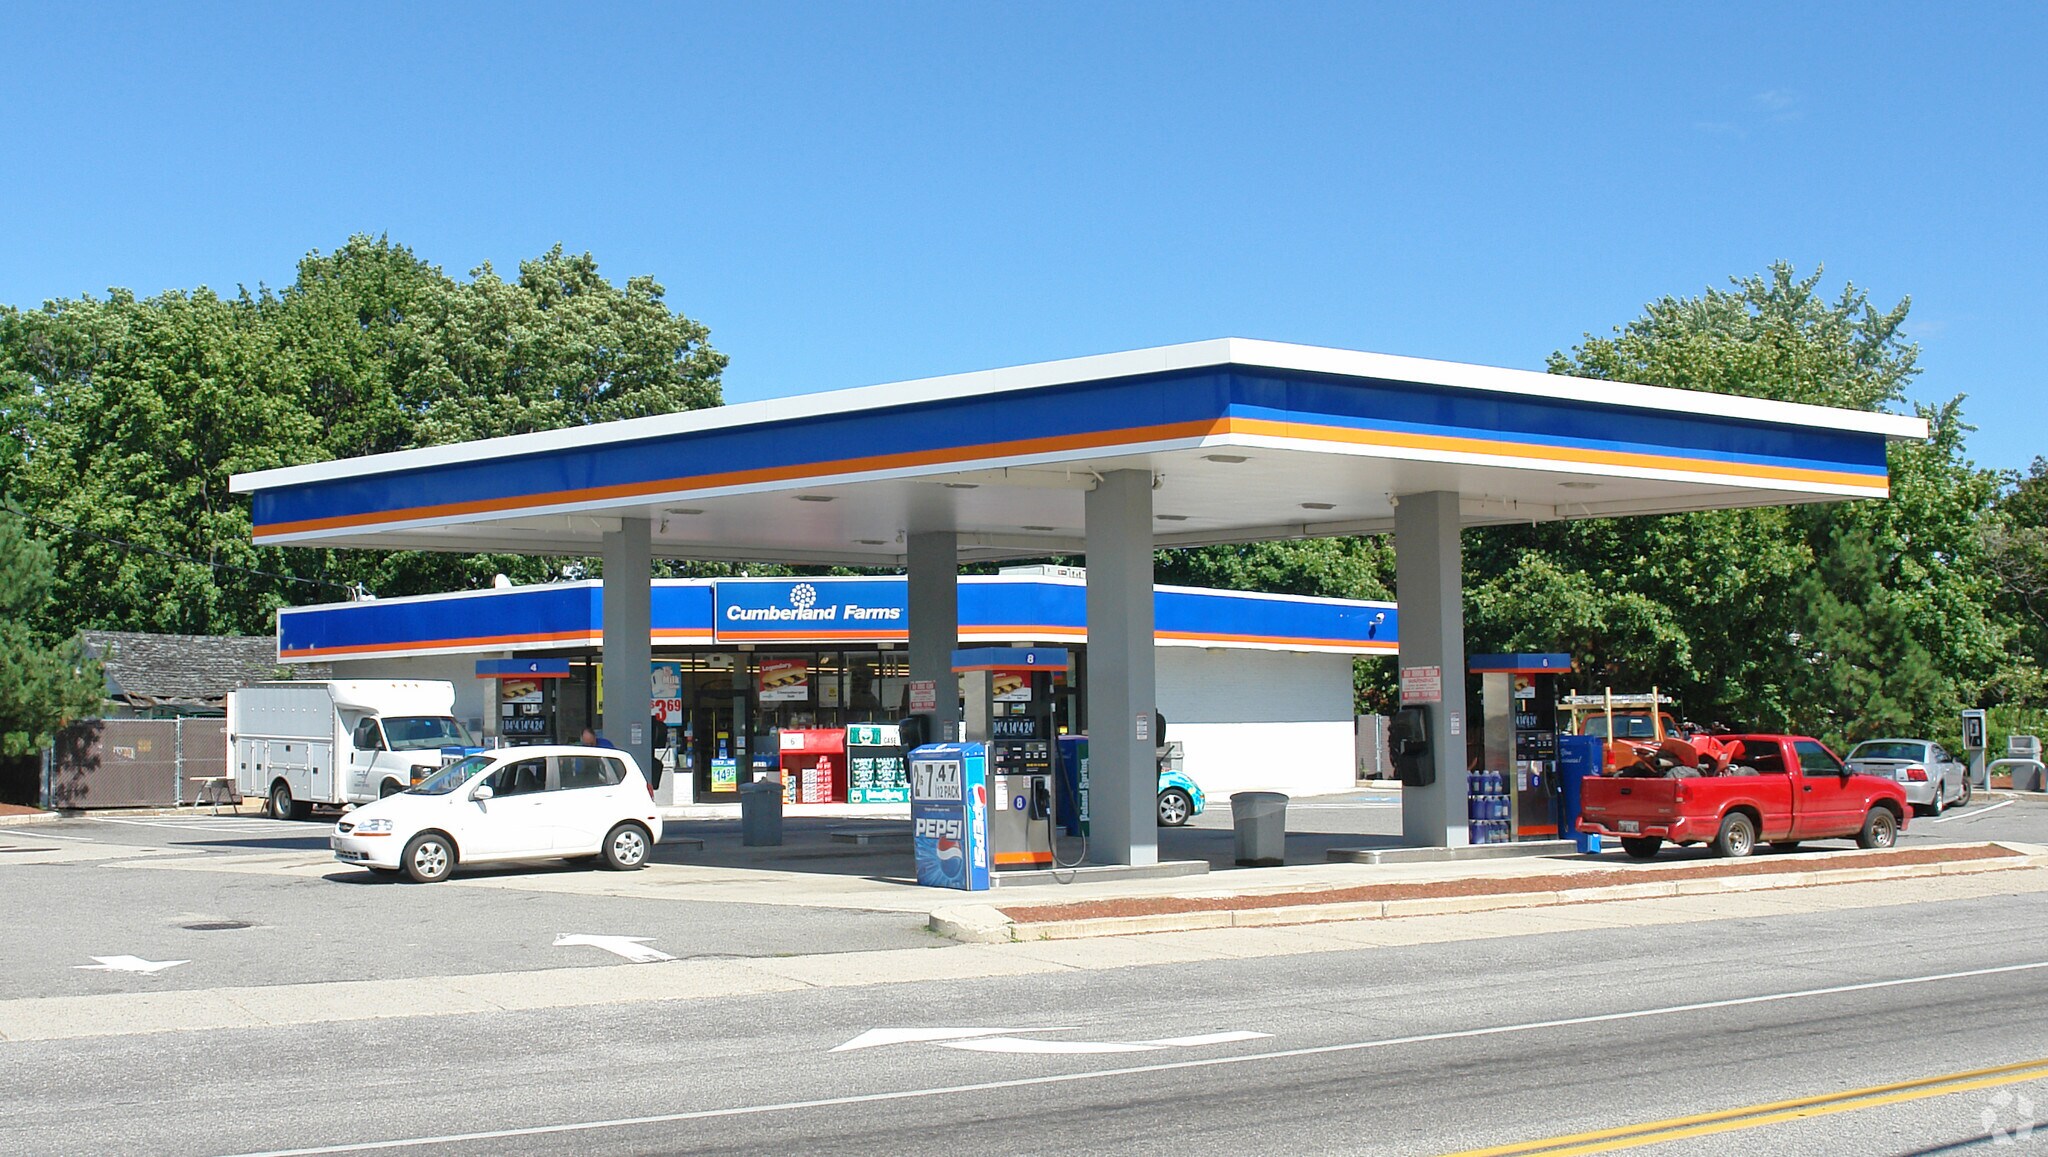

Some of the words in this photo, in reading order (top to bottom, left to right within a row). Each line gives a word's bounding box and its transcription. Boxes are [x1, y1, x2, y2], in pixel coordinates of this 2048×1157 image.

[726, 603, 838, 621] Cumberland
[843, 604, 902, 620] Farms
[1026, 653, 1034, 664] 8
[1542, 658, 1549, 667] 6
[529, 662, 538, 672] 4
[1533, 776, 1539, 786] 6
[944, 785, 960, 798] PACK
[1016, 797, 1023, 809] 8
[915, 818, 962, 839] PEPSI
